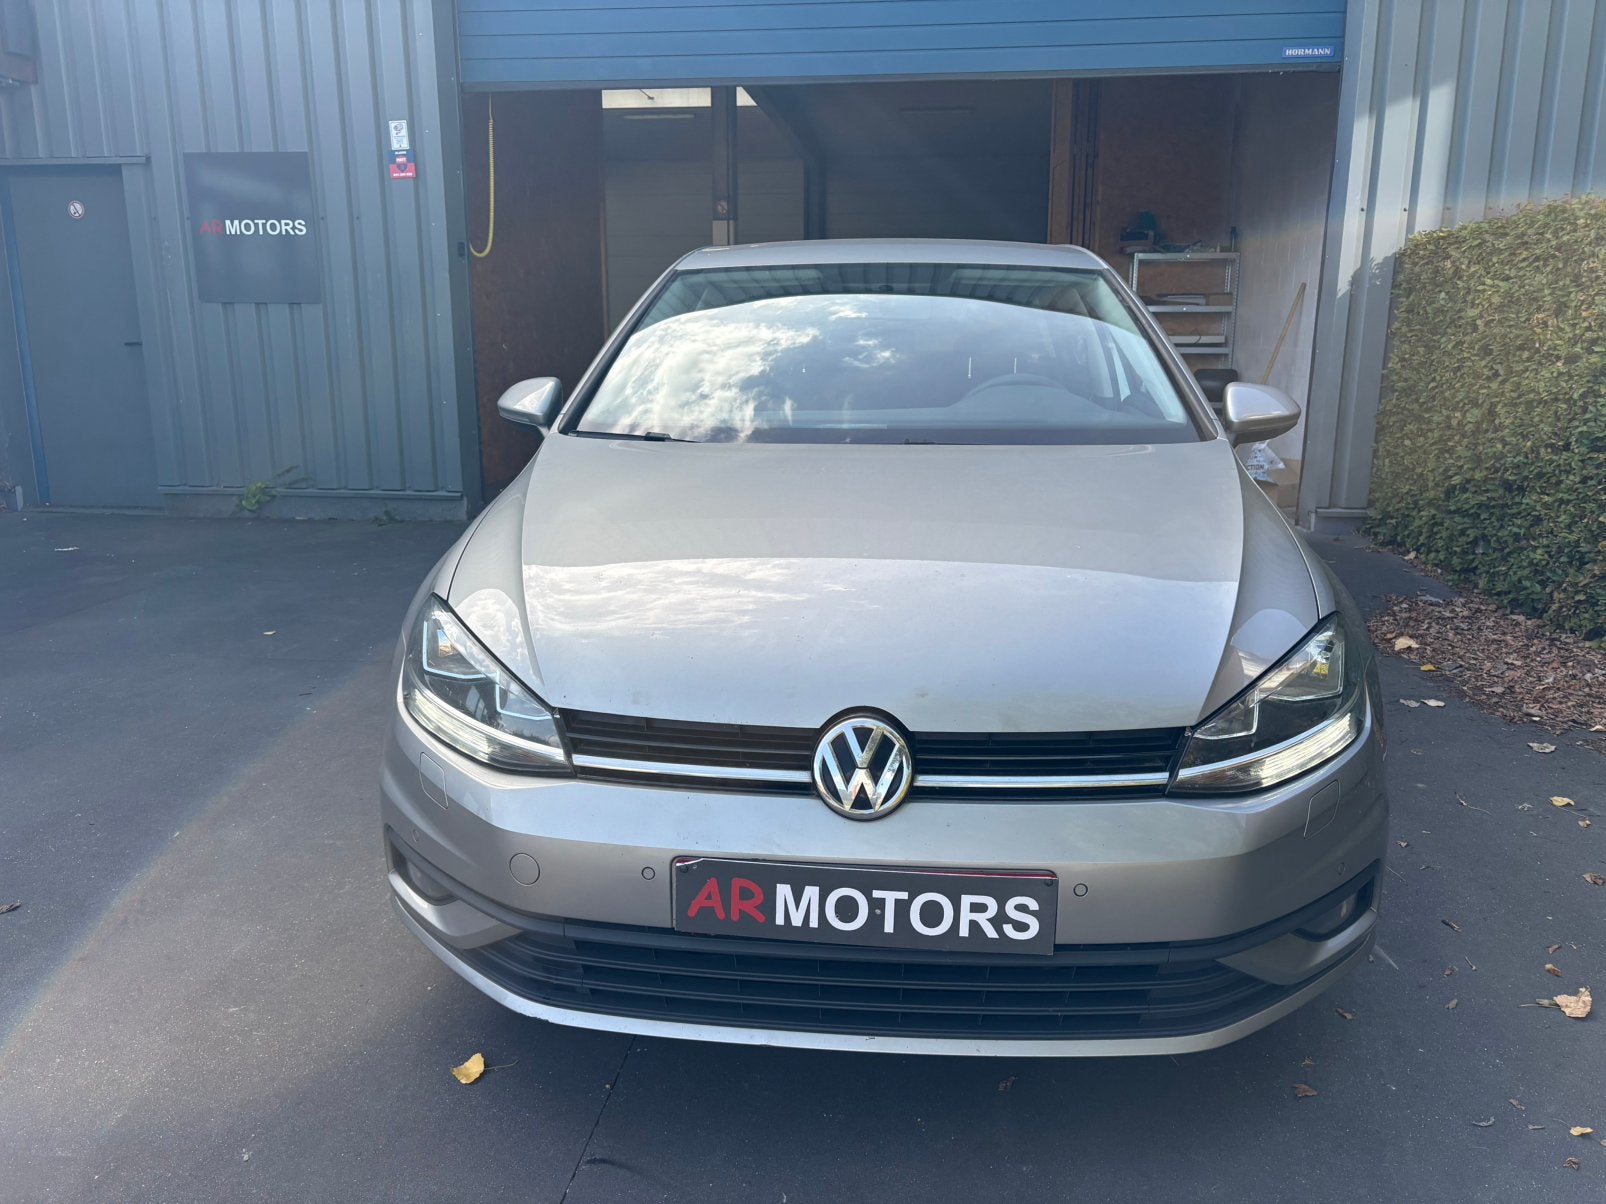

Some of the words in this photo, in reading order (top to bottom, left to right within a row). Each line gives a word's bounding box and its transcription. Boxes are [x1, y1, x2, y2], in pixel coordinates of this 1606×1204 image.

[224, 219, 307, 235] MOTORS
[817, 720, 906, 815] VW
[774, 883, 1041, 941] MOTORS
